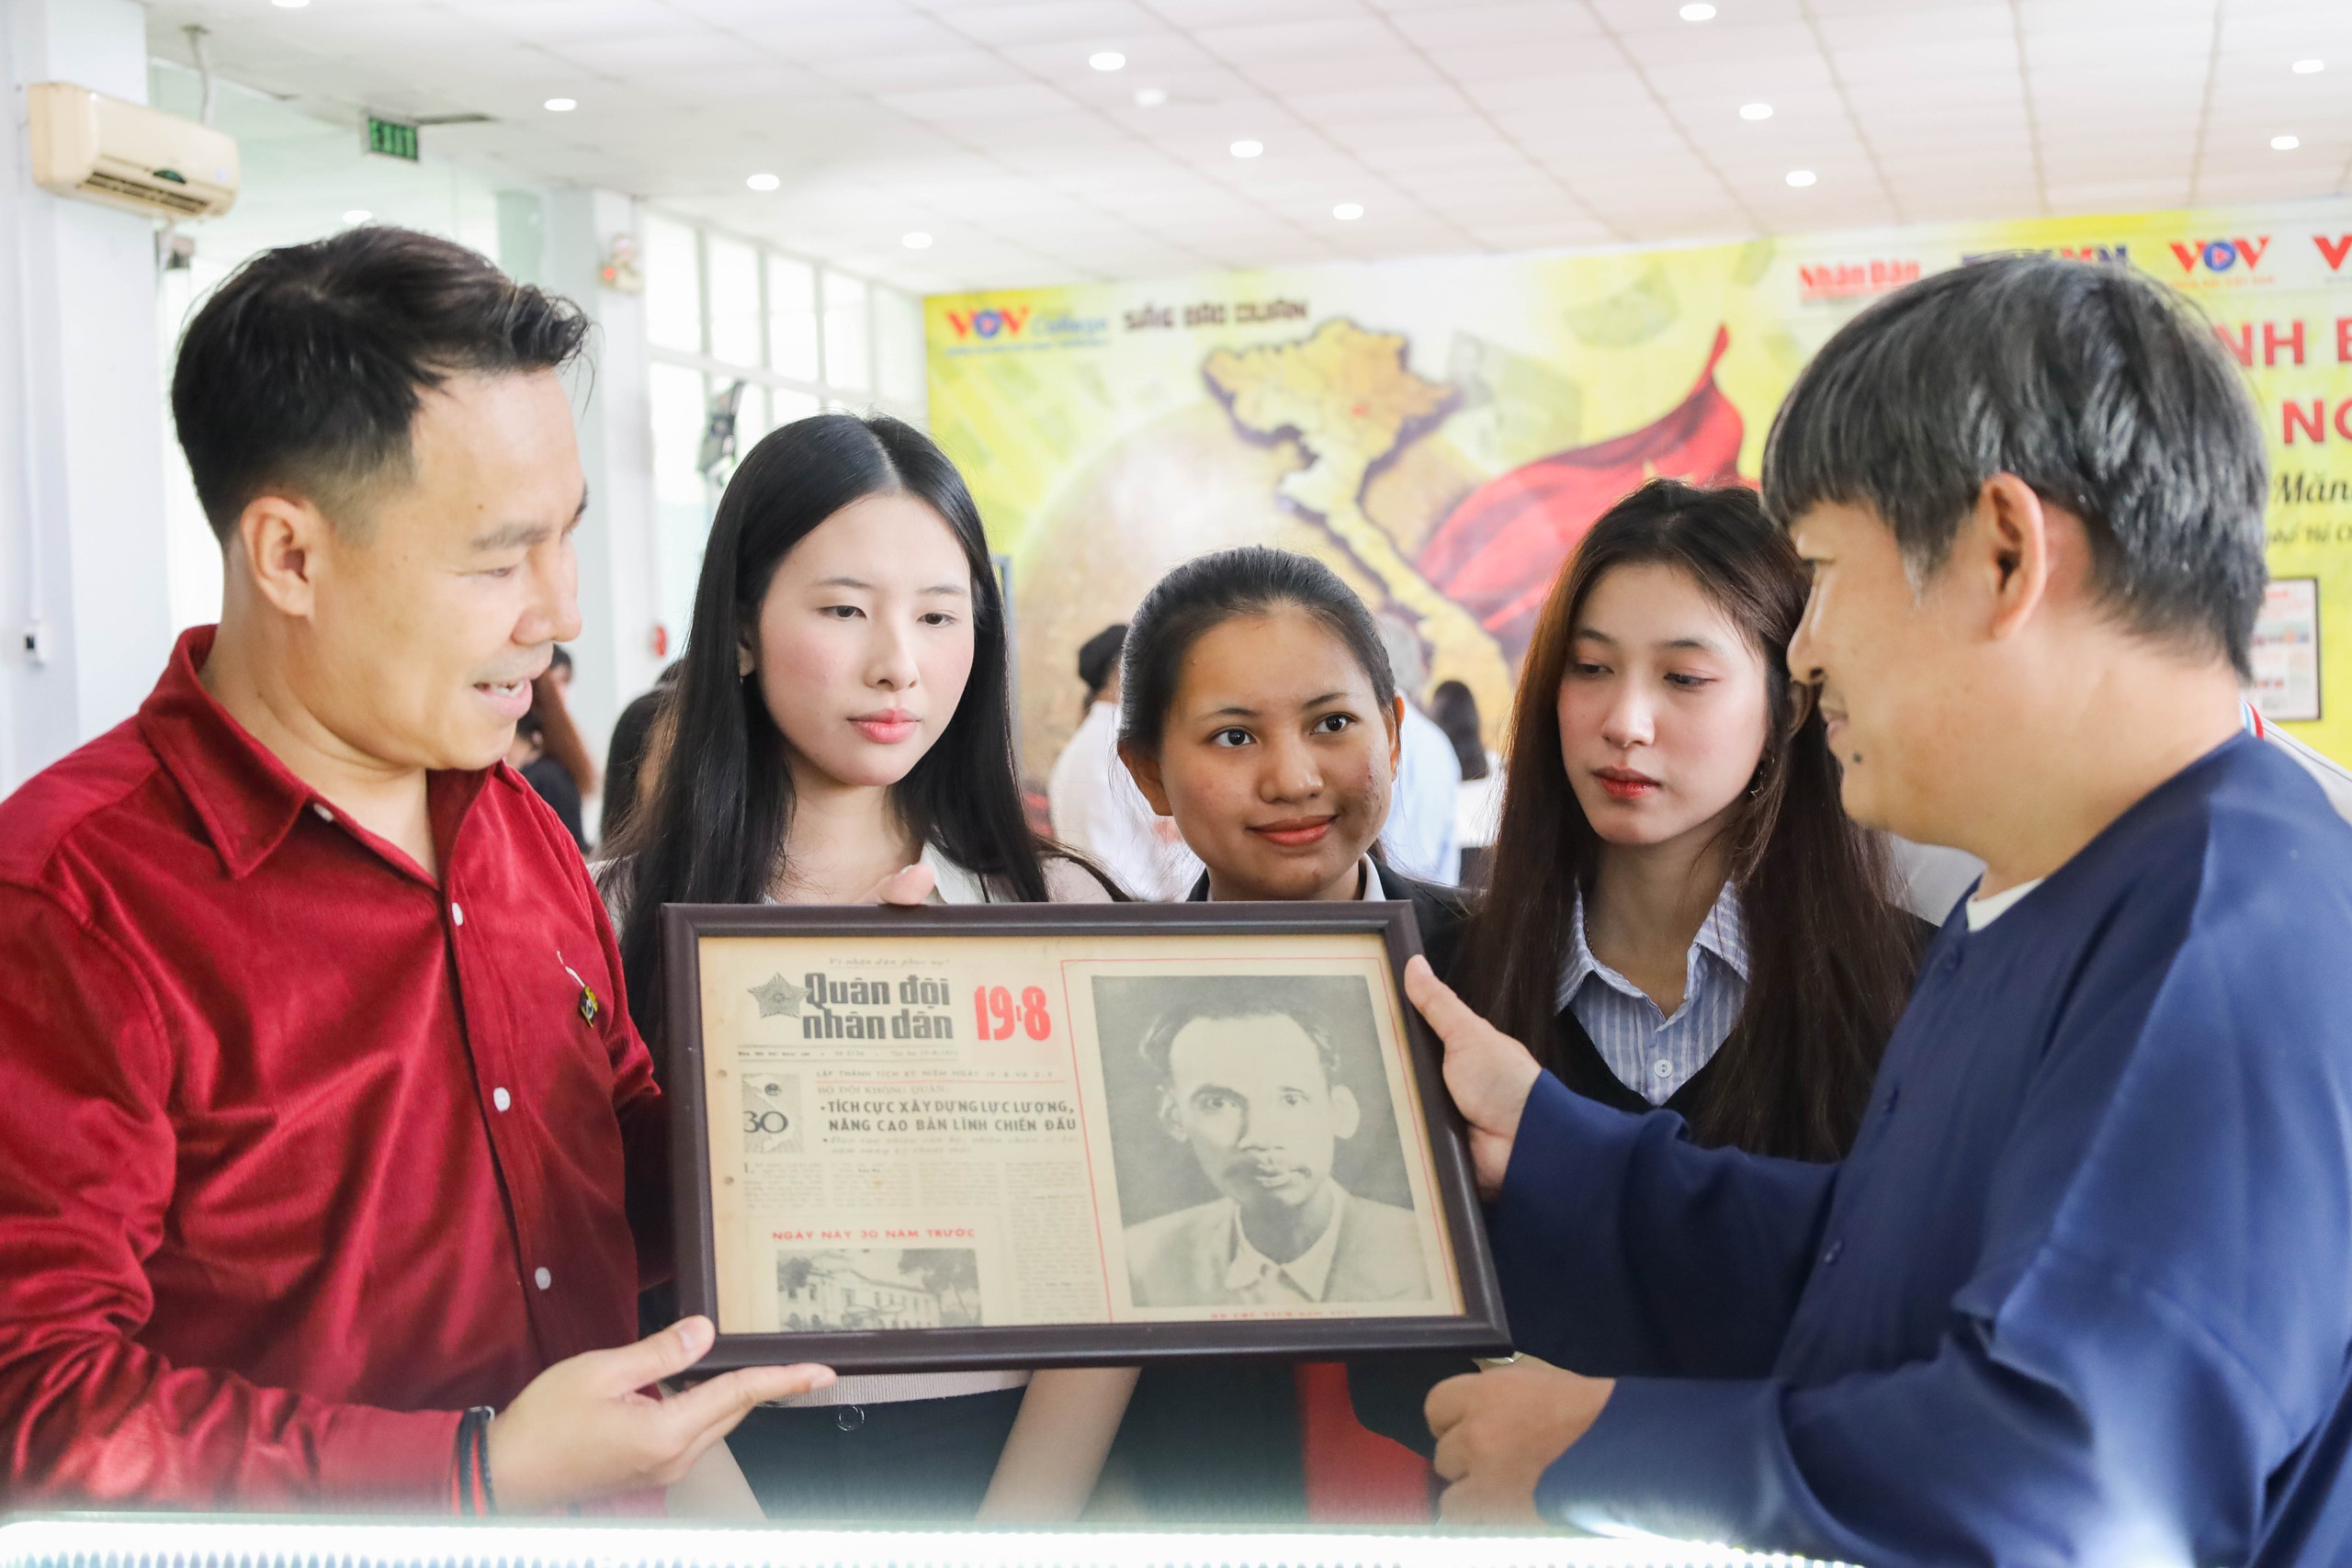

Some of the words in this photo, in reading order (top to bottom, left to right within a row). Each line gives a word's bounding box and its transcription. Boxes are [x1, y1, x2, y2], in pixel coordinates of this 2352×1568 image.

[2169, 235, 2270, 273] VOV
[946, 306, 1029, 340] VOV
[805, 973, 890, 1010] Quân
[899, 975, 950, 1009] đội
[803, 1008, 886, 1039] nhân
[891, 1008, 954, 1039] dân
[877, 1119, 908, 1132] CAO
